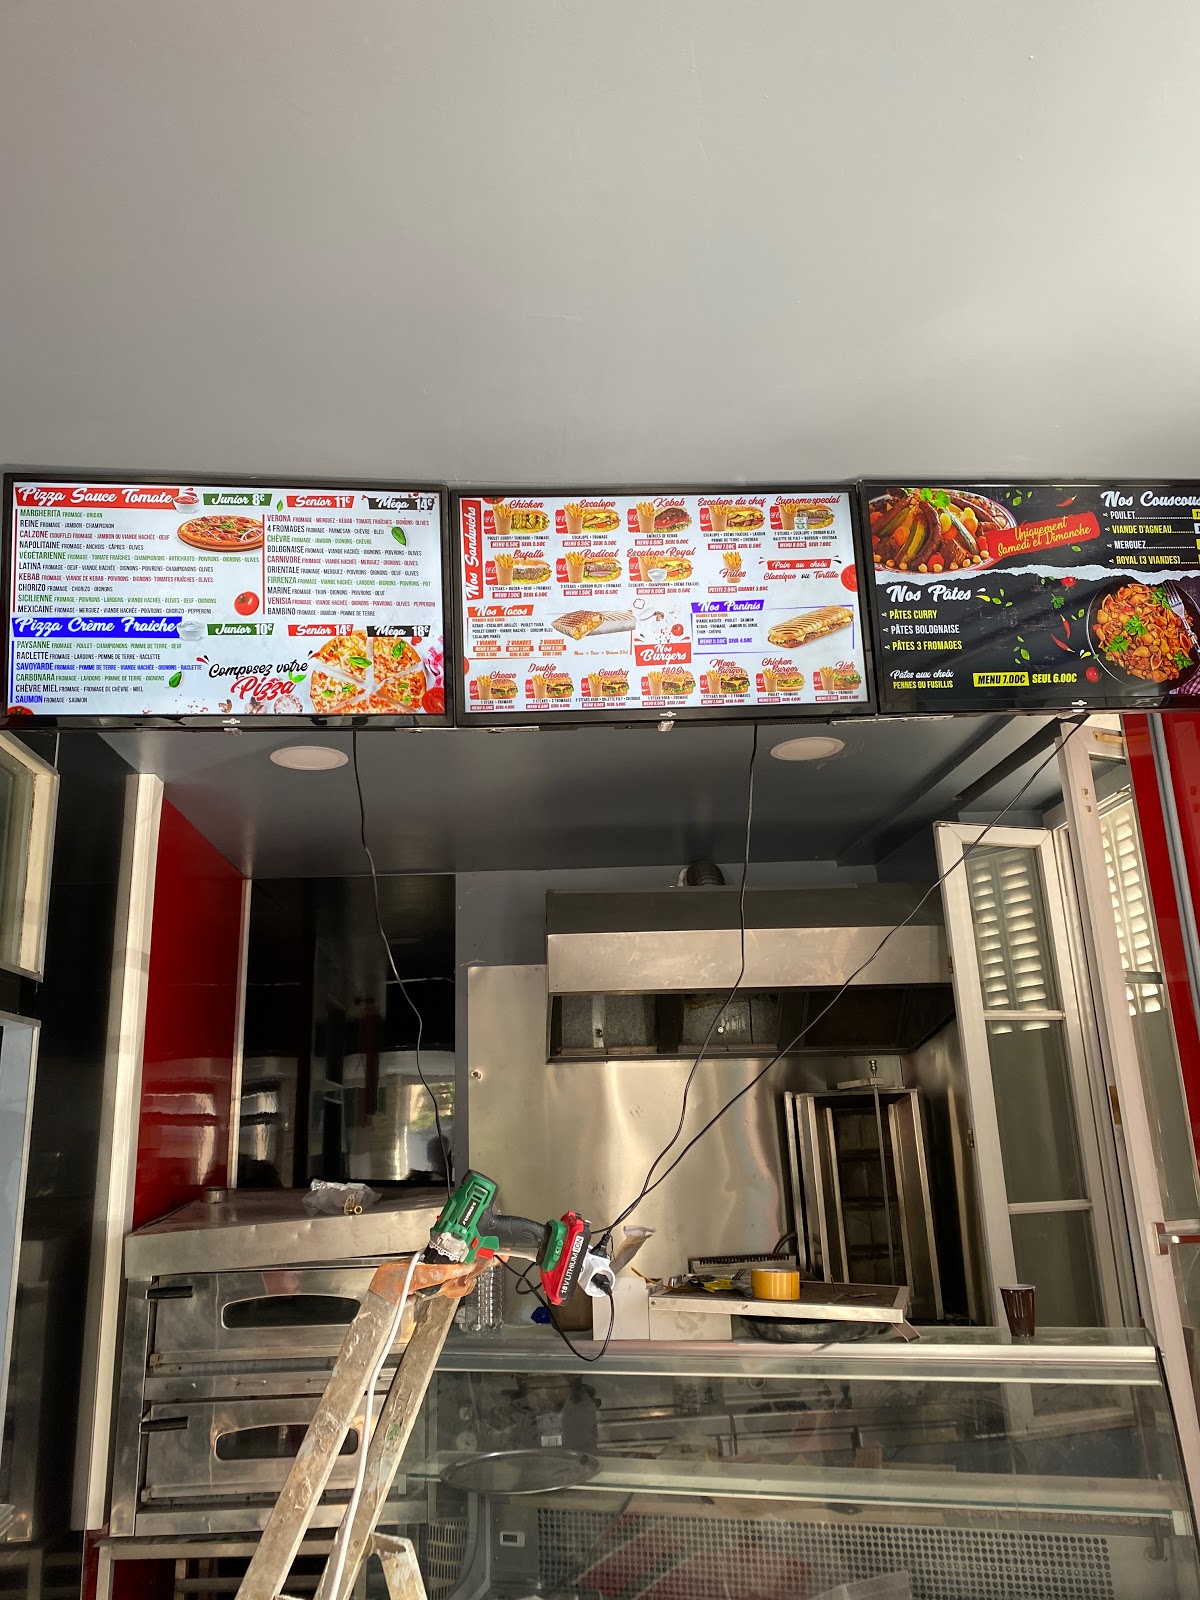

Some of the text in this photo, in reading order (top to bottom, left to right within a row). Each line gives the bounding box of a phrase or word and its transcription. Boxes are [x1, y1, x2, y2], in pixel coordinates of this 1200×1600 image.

[18, 486, 173, 506] Pizza Sauce Tomate
[211, 493, 249, 505] Junior
[295, 495, 332, 507] Senior
[1100, 490, 1134, 508] Nos
[509, 499, 544, 509] Chicken
[579, 499, 616, 510] Escalope
[653, 498, 685, 508] Kebab
[697, 496, 768, 507] Escalope du chef
[20, 509, 61, 518] MARGHERITA
[267, 514, 291, 523] VERONA
[20, 519, 39, 528] REINE
[1014, 516, 1068, 541] Uniquement
[267, 525, 271, 533] 4
[272, 525, 305, 533] FROMAGES
[1111, 524, 1138, 535] VIANDE
[19, 530, 48, 539] CALZONE
[267, 534, 291, 543] CHÈVRE
[19, 541, 60, 549] NAPOLITAINE
[997, 525, 1092, 557] Samedi et Dimanche
[1114, 540, 1147, 550] MERGUEZ
[267, 545, 304, 554] BOLOGNAISE
[464, 506, 480, 598] Nos Sandwichs
[580, 548, 620, 558] Radical
[626, 547, 697, 558] Escalope Royal
[19, 550, 66, 560] VÉGÉTARIENNE
[267, 555, 301, 564] CARNIVORE
[512, 549, 545, 561] Bufallo
[1116, 555, 1181, 565] ROYAL (3 VIANDES)
[19, 562, 41, 570] LATINA
[267, 565, 299, 574] ORIENTALE
[772, 561, 790, 569] Pain
[809, 560, 828, 568] choix
[19, 573, 40, 581] KEBAB
[267, 576, 297, 584] FIRRENZA
[763, 572, 797, 582] Classique
[813, 571, 839, 579] Tortilla
[18, 583, 46, 592] CHORIZO
[267, 586, 291, 595] MARINE
[18, 594, 53, 603] SICILIENNE
[886, 584, 972, 603] Nos Pâtes
[267, 597, 291, 605] VENISIA
[697, 600, 762, 612] Nos Paninis
[17, 605, 53, 613] MEXICAINE
[267, 607, 296, 616] BAMBINO
[474, 606, 528, 616] Nos Tacos
[889, 608, 938, 620] PÂTES CURRY
[14, 617, 62, 637] Pizza
[67, 617, 115, 632] Crème
[215, 623, 252, 635] Junior
[295, 624, 332, 636] Senior
[890, 623, 960, 635] PÂTES BOLOGNAISE
[17, 640, 50, 649] PAYSANNE
[654, 644, 672, 653] Nos
[892, 640, 963, 651] PÂTES 3 FROMAGES
[16, 651, 48, 660] RACLETTE
[639, 649, 687, 665] Burgers
[16, 662, 54, 671] SAVOYARDE
[208, 659, 309, 680] Composez votre
[15, 673, 55, 682] CARBONARA
[598, 667, 630, 678] Country
[890, 669, 915, 680] Pâtes
[932, 669, 955, 679] choix
[978, 675, 1001, 685] MENU
[1032, 673, 1052, 683] SEUL
[15, 683, 58, 692] CHÈVRE MIEL
[230, 675, 297, 702] Pizza
[893, 680, 954, 690] PENNES OU FUSILLIS
[15, 694, 43, 703] SAUMON
[564, 1252, 579, 1281] LITHIUM
[573, 1237, 583, 1251] ION
